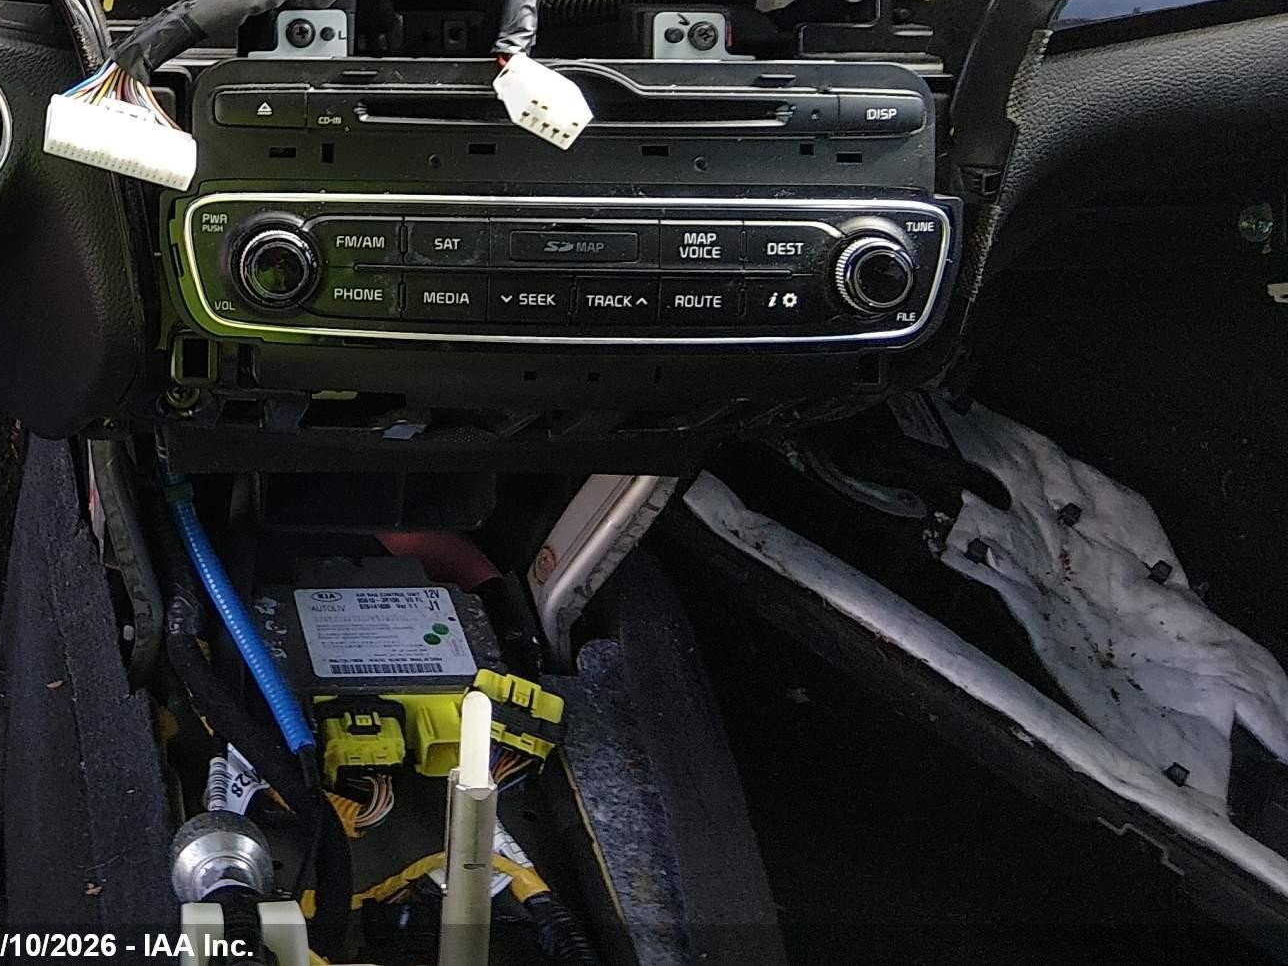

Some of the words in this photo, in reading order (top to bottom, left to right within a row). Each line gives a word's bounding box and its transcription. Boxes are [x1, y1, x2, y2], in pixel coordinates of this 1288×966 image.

[318, 116, 342, 124] CD-IN
[866, 108, 897, 121] DISP
[201, 213, 228, 224] PWR
[201, 224, 224, 233] PUSH
[905, 221, 935, 233] TUNE
[336, 235, 385, 249] FM/AM
[434, 238, 461, 251] SAT
[684, 233, 717, 245] MAP
[576, 242, 605, 253] MAP
[679, 246, 721, 259] VOICE
[766, 242, 805, 256] DEST
[334, 288, 384, 302] PHONE
[423, 291, 470, 305] MEDIA
[519, 293, 556, 306] SEEK
[586, 295, 633, 308] TRACK
[674, 294, 723, 308] ROUTE
[214, 301, 236, 311] VOL
[896, 312, 917, 322] FILE
